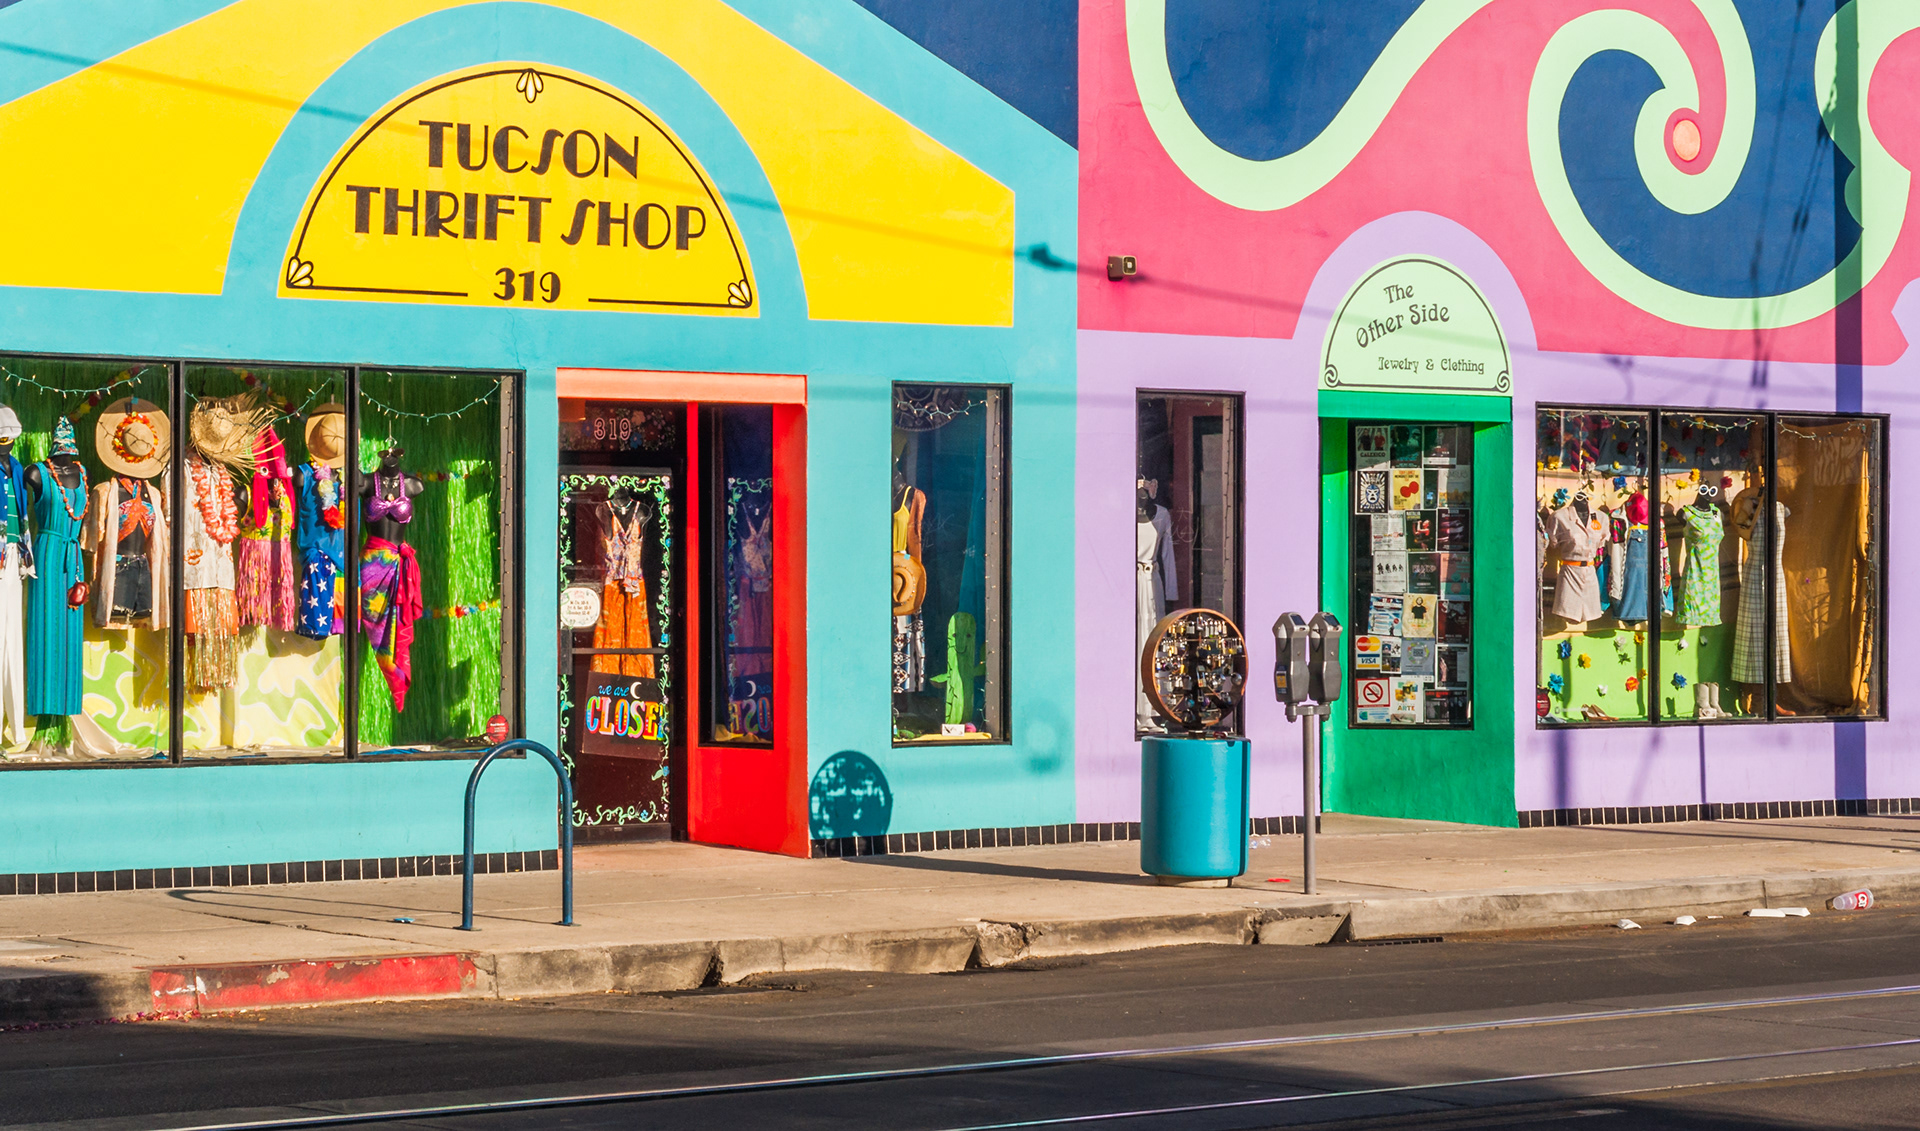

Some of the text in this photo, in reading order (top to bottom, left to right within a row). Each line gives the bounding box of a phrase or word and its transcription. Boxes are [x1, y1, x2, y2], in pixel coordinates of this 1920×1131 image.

[418, 120, 639, 179] TUCSON
[346, 184, 706, 251] THRIFT SHOP
[493, 266, 561, 303] 319
[1384, 284, 1414, 304] The
[1356, 303, 1450, 348] Other Side
[1378, 357, 1485, 375] Jewelry & Clothing
[594, 417, 631, 441] 319
[598, 684, 629, 697] we are
